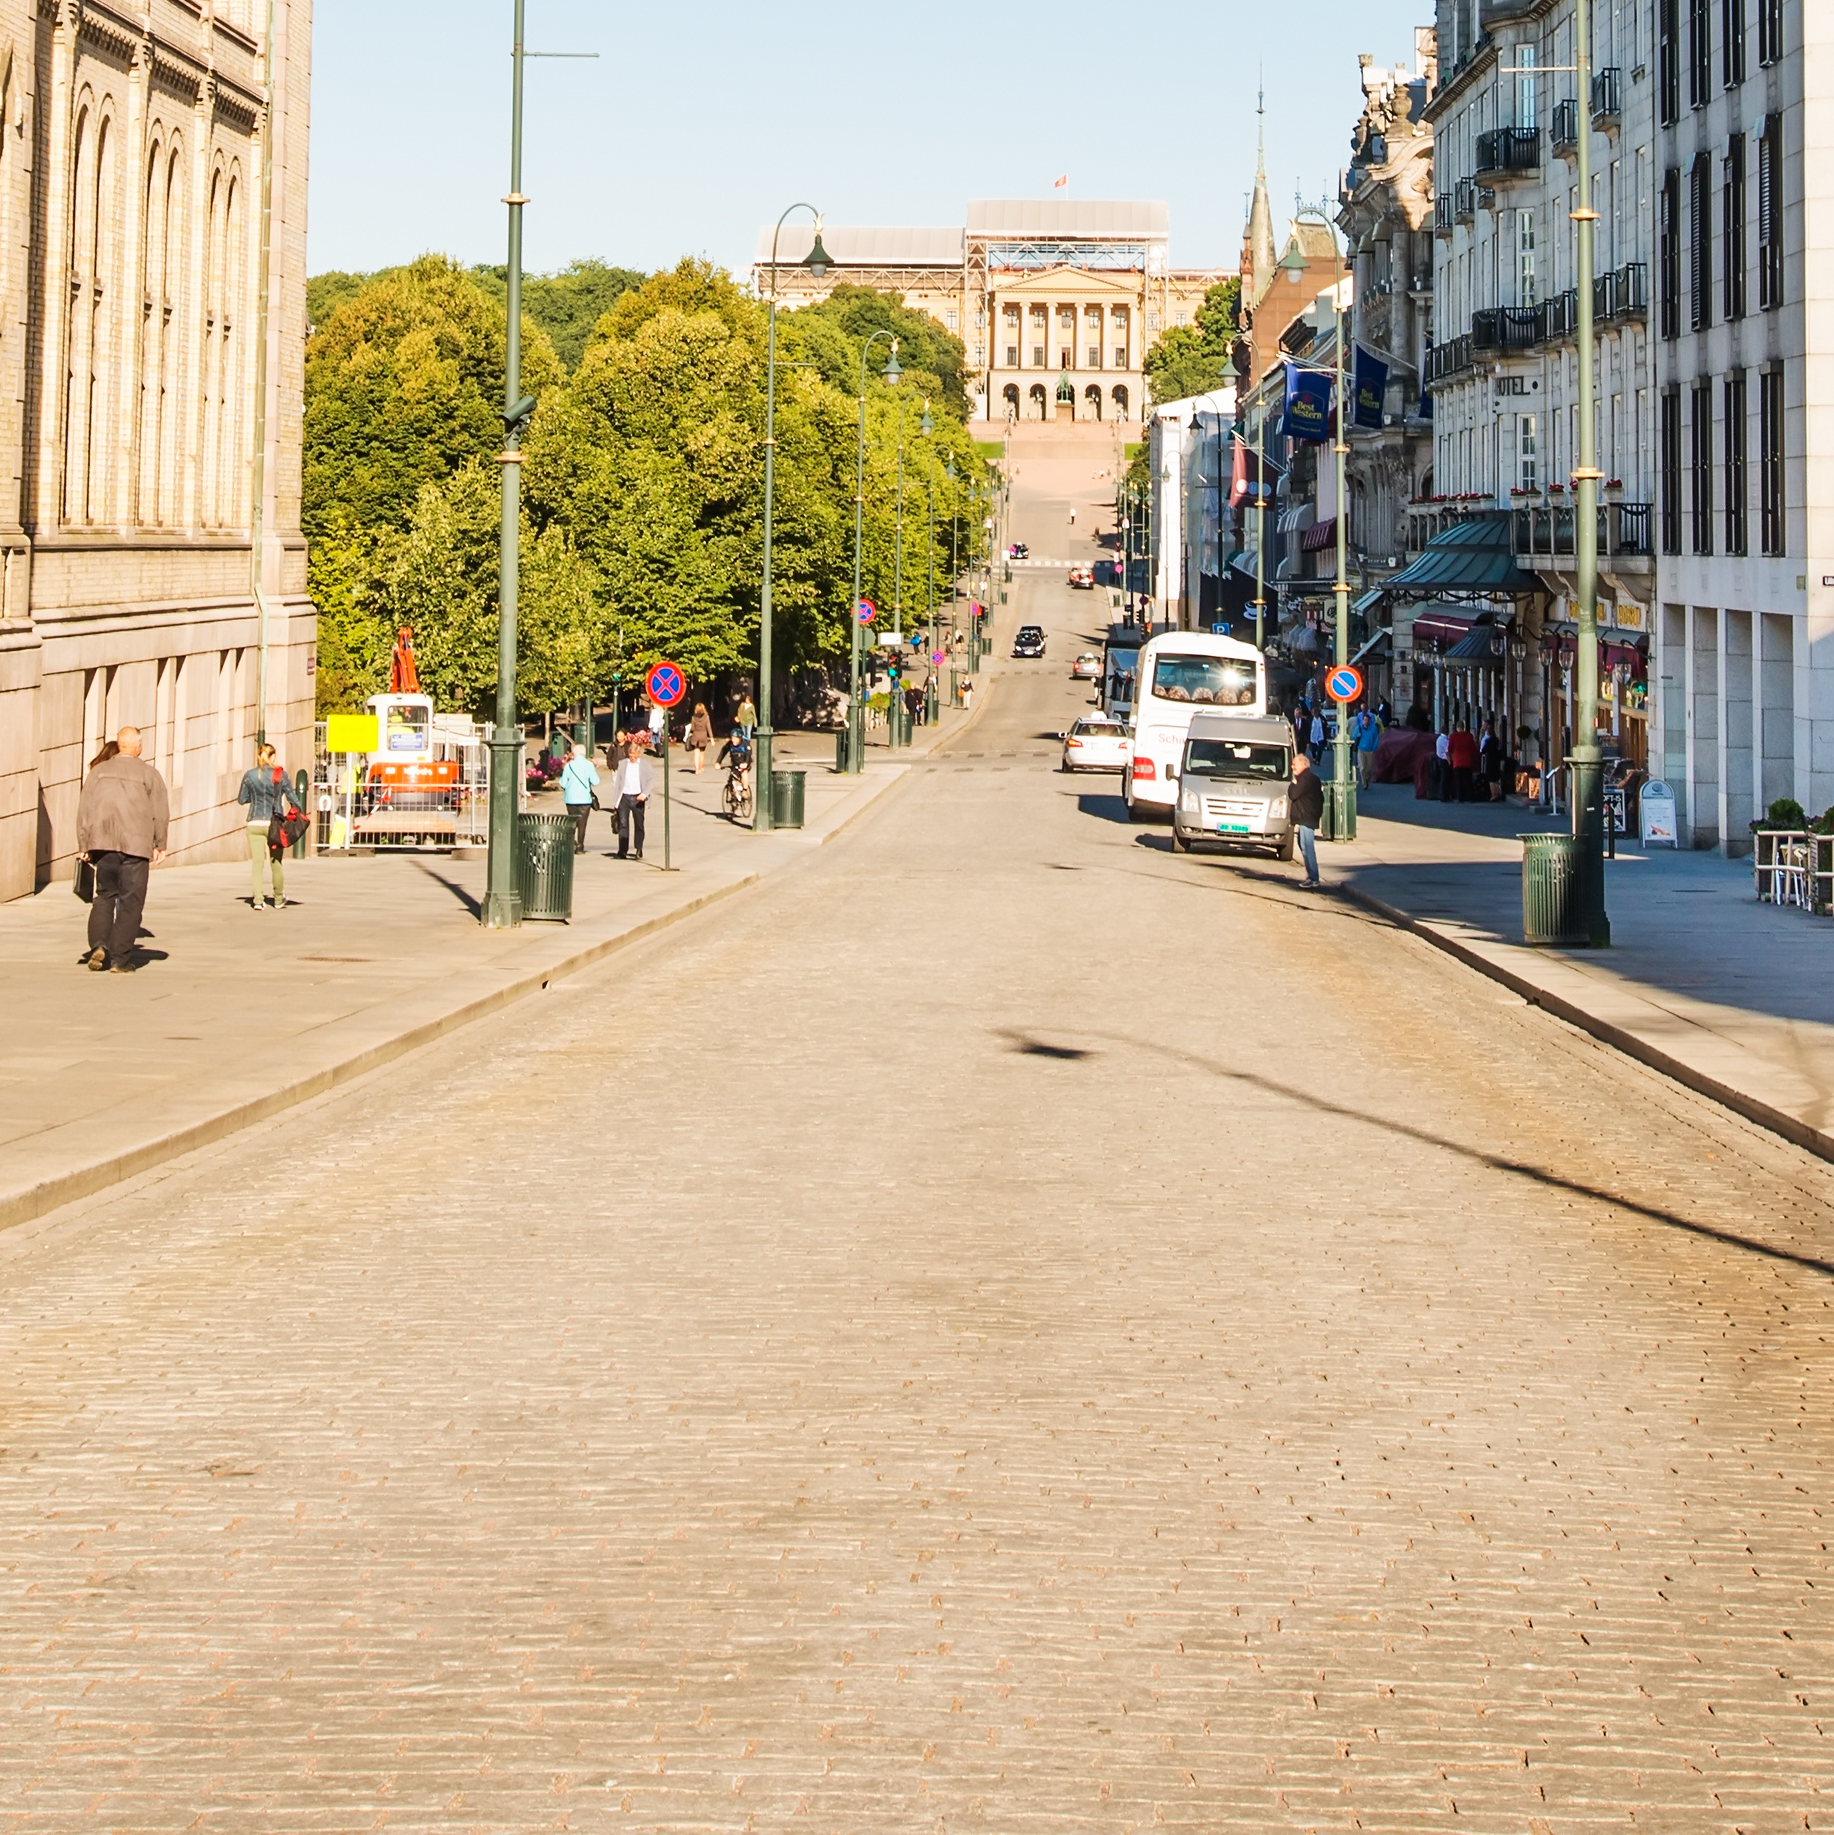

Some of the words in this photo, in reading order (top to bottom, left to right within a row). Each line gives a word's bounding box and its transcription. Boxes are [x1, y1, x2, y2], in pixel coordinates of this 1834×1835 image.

[1297, 400, 1315, 411] Best
[1292, 405, 1322, 420] Western
[1158, 733, 1186, 744] Scha
